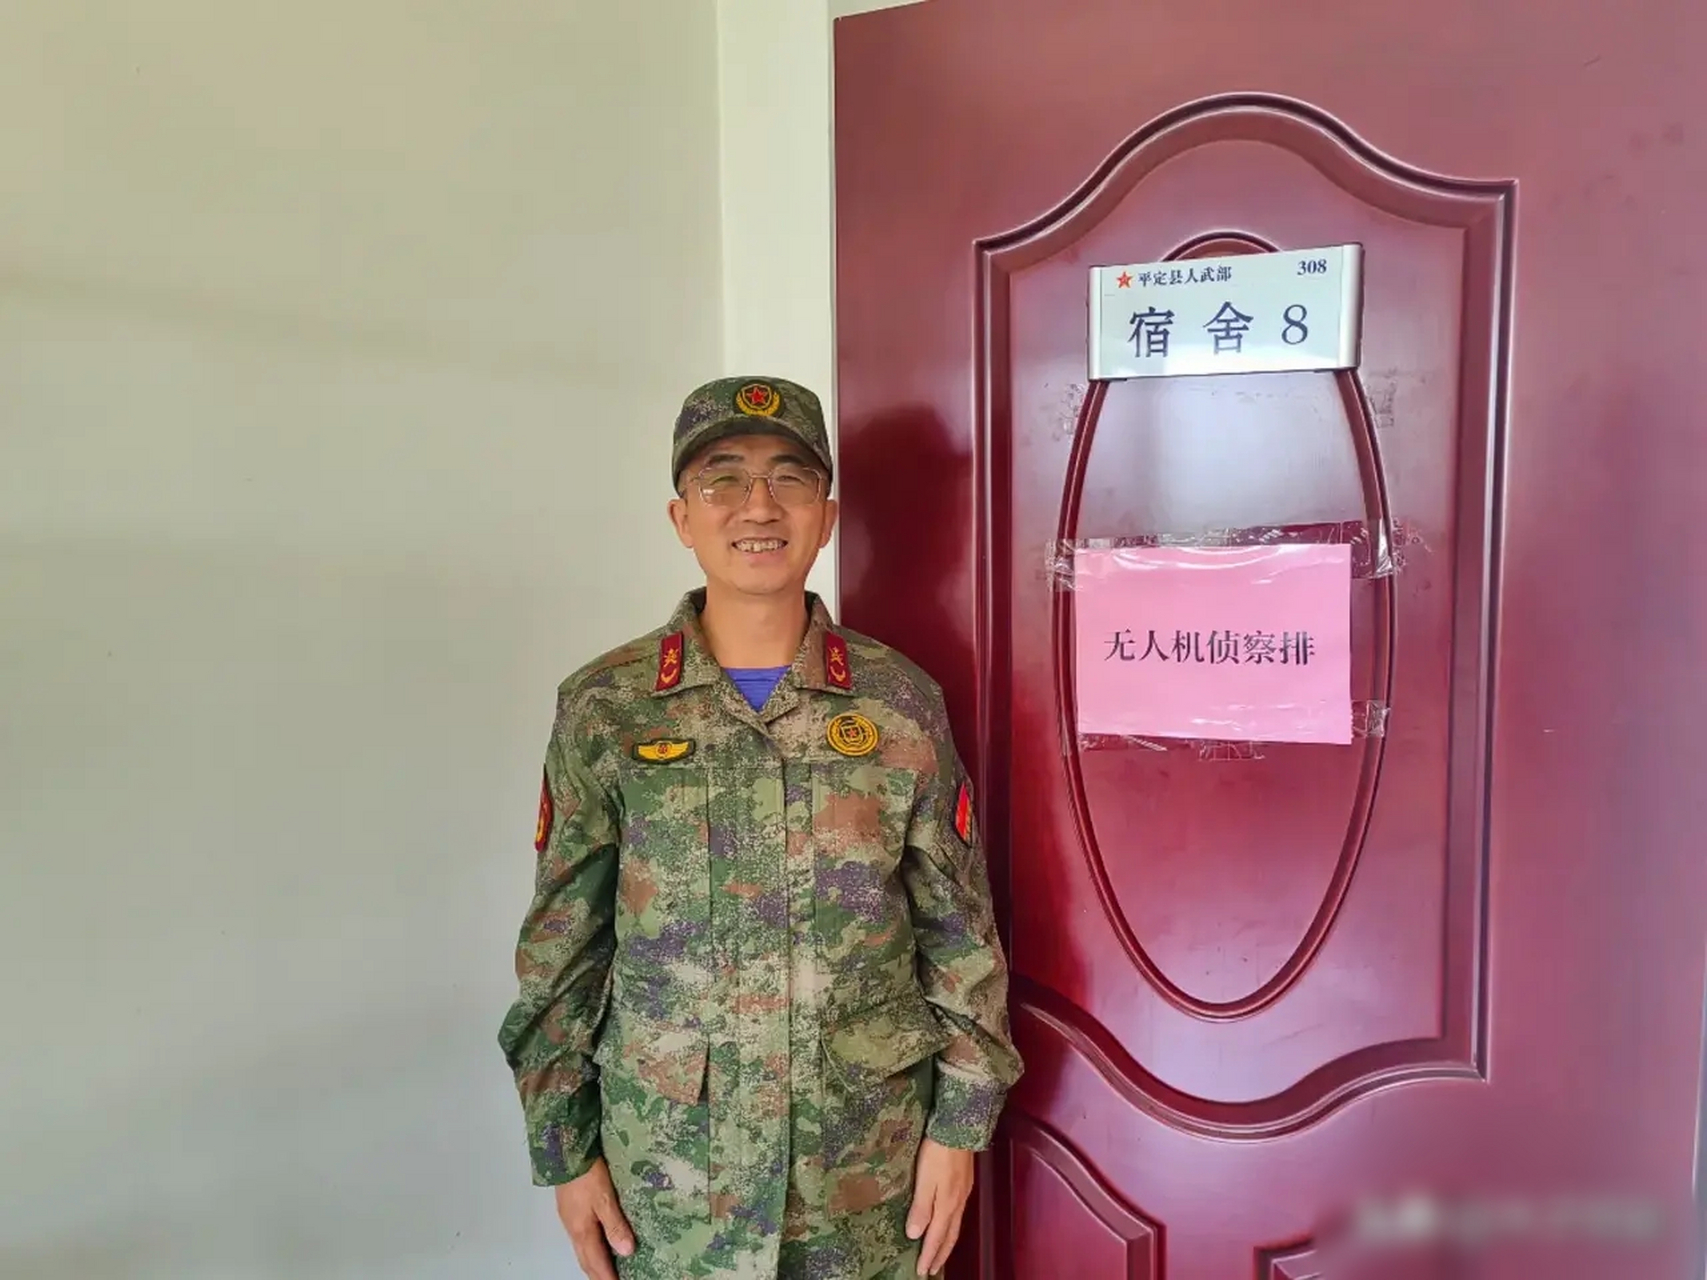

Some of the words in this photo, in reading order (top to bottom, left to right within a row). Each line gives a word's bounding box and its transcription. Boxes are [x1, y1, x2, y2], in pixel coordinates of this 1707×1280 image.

[1137, 265, 1232, 288] 平定县人武部
[1297, 259, 1327, 276] 308
[1104, 628, 1315, 666] 无人机侦察排
